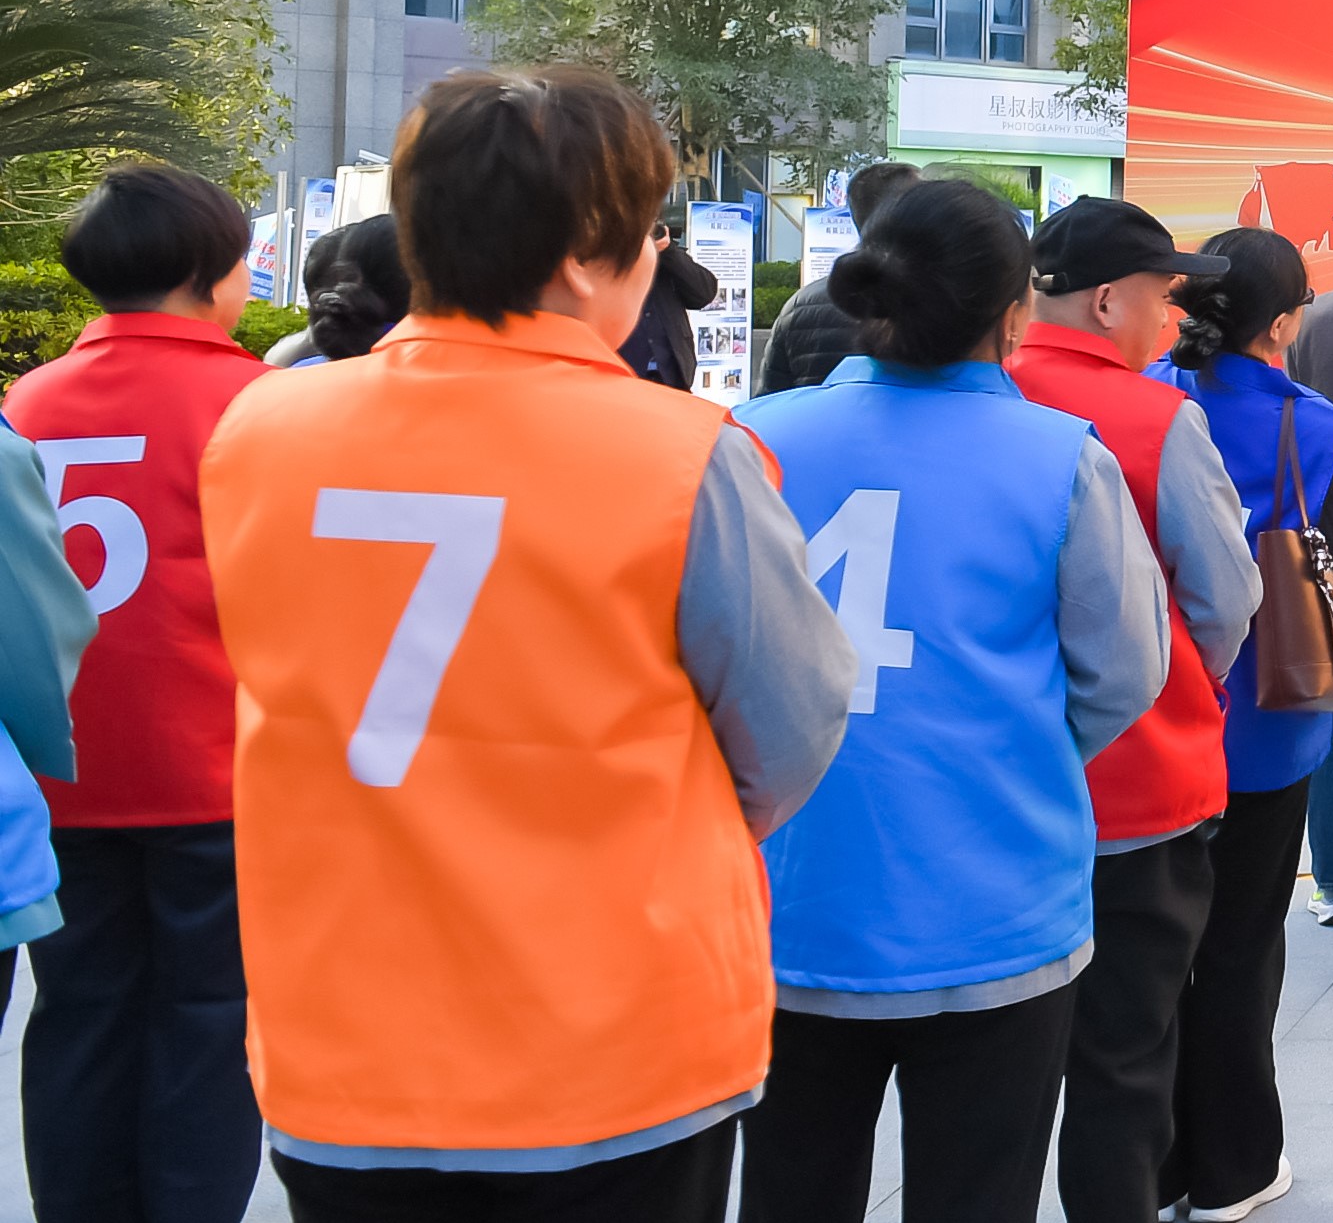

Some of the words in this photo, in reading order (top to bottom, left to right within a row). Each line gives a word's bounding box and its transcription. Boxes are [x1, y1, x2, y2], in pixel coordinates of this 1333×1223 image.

[1002, 121, 1071, 134] PHOTOGRAPHY
[36, 435, 149, 615] 5
[806, 488, 914, 714] 4
[311, 487, 507, 788] 7
